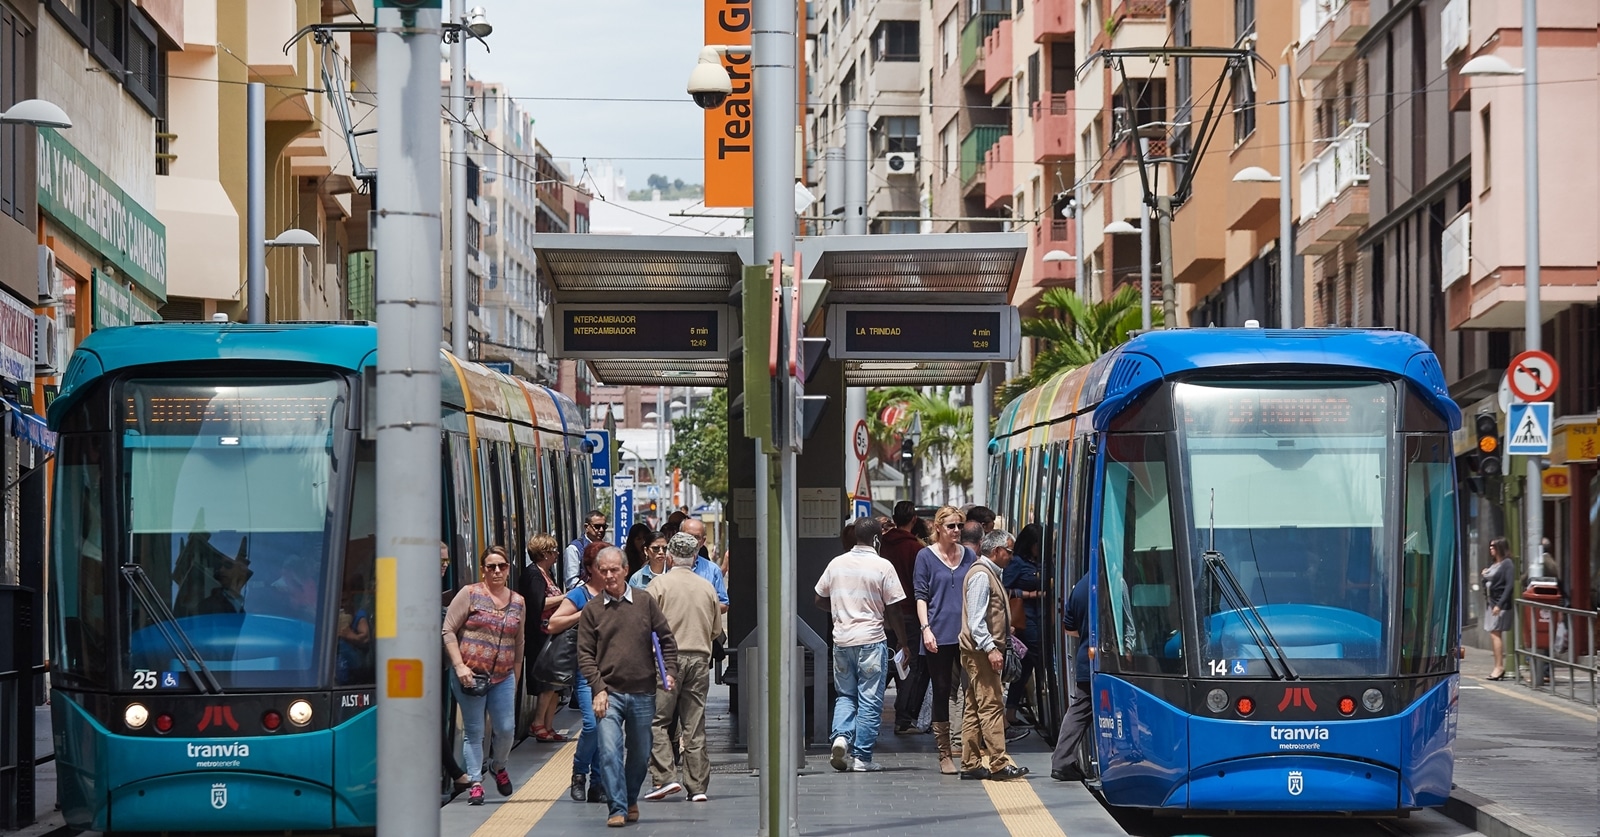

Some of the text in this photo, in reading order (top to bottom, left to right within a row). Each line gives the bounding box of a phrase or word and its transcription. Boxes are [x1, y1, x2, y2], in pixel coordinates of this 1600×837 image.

[718, 0, 751, 32] G
[37, 133, 166, 285] DA Y COMPLEMENTOS CANARIAS
[574, 327, 636, 335] INTERCAMBIADOR
[696, 326, 709, 335] min
[855, 327, 866, 335] LA
[869, 327, 901, 335] TRINIDAD
[978, 328, 991, 336] min
[690, 339, 707, 347] 12:49
[1208, 659, 1228, 676] 14
[132, 671, 157, 690] 25
[394, 663, 413, 691] T
[341, 693, 370, 708] ALSTOM
[1270, 726, 1329, 740] tranvía
[187, 741, 249, 758] tranvía
[1279, 742, 1320, 750] metrotenerife
[197, 759, 240, 768] metrotenerife
